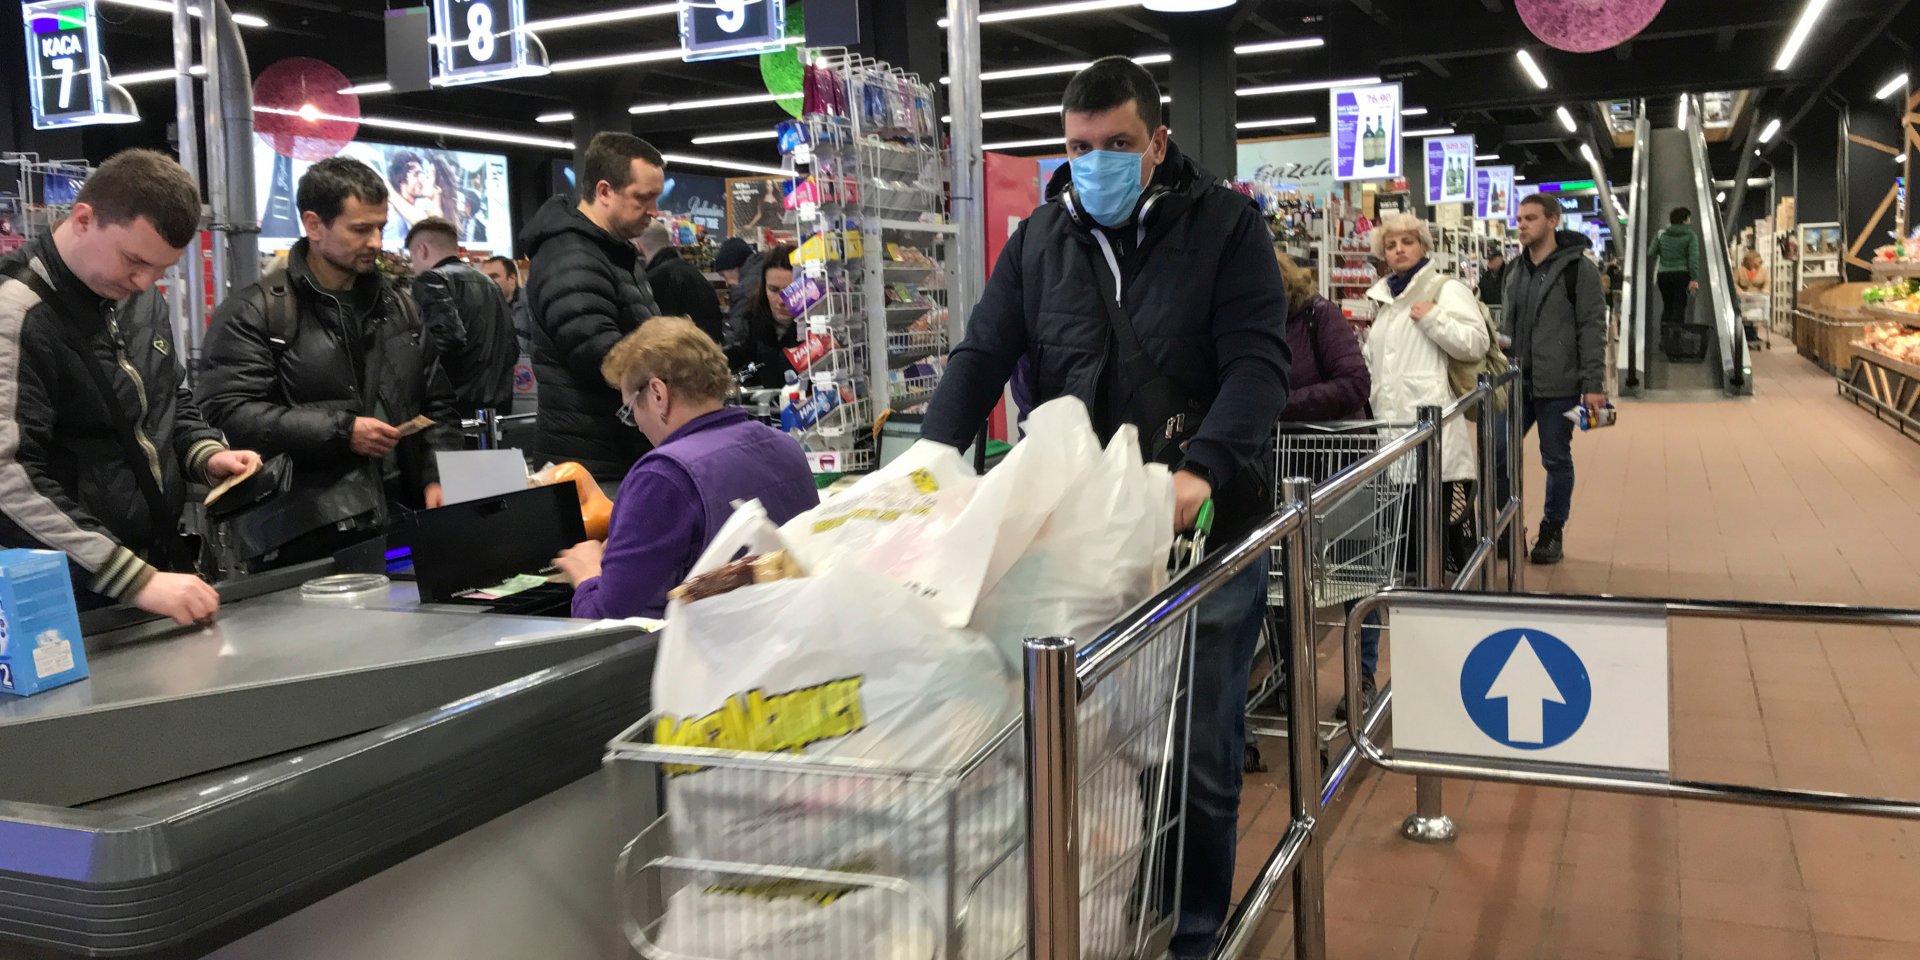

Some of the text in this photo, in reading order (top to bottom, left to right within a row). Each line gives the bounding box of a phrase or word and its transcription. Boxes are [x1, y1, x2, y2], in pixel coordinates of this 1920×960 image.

[467, 3, 494, 61] 8
[42, 34, 82, 57] КАСА
[52, 58, 73, 109] 7
[788, 280, 816, 307] HALS
[792, 337, 819, 363] HALS
[799, 394, 825, 419] HALS
